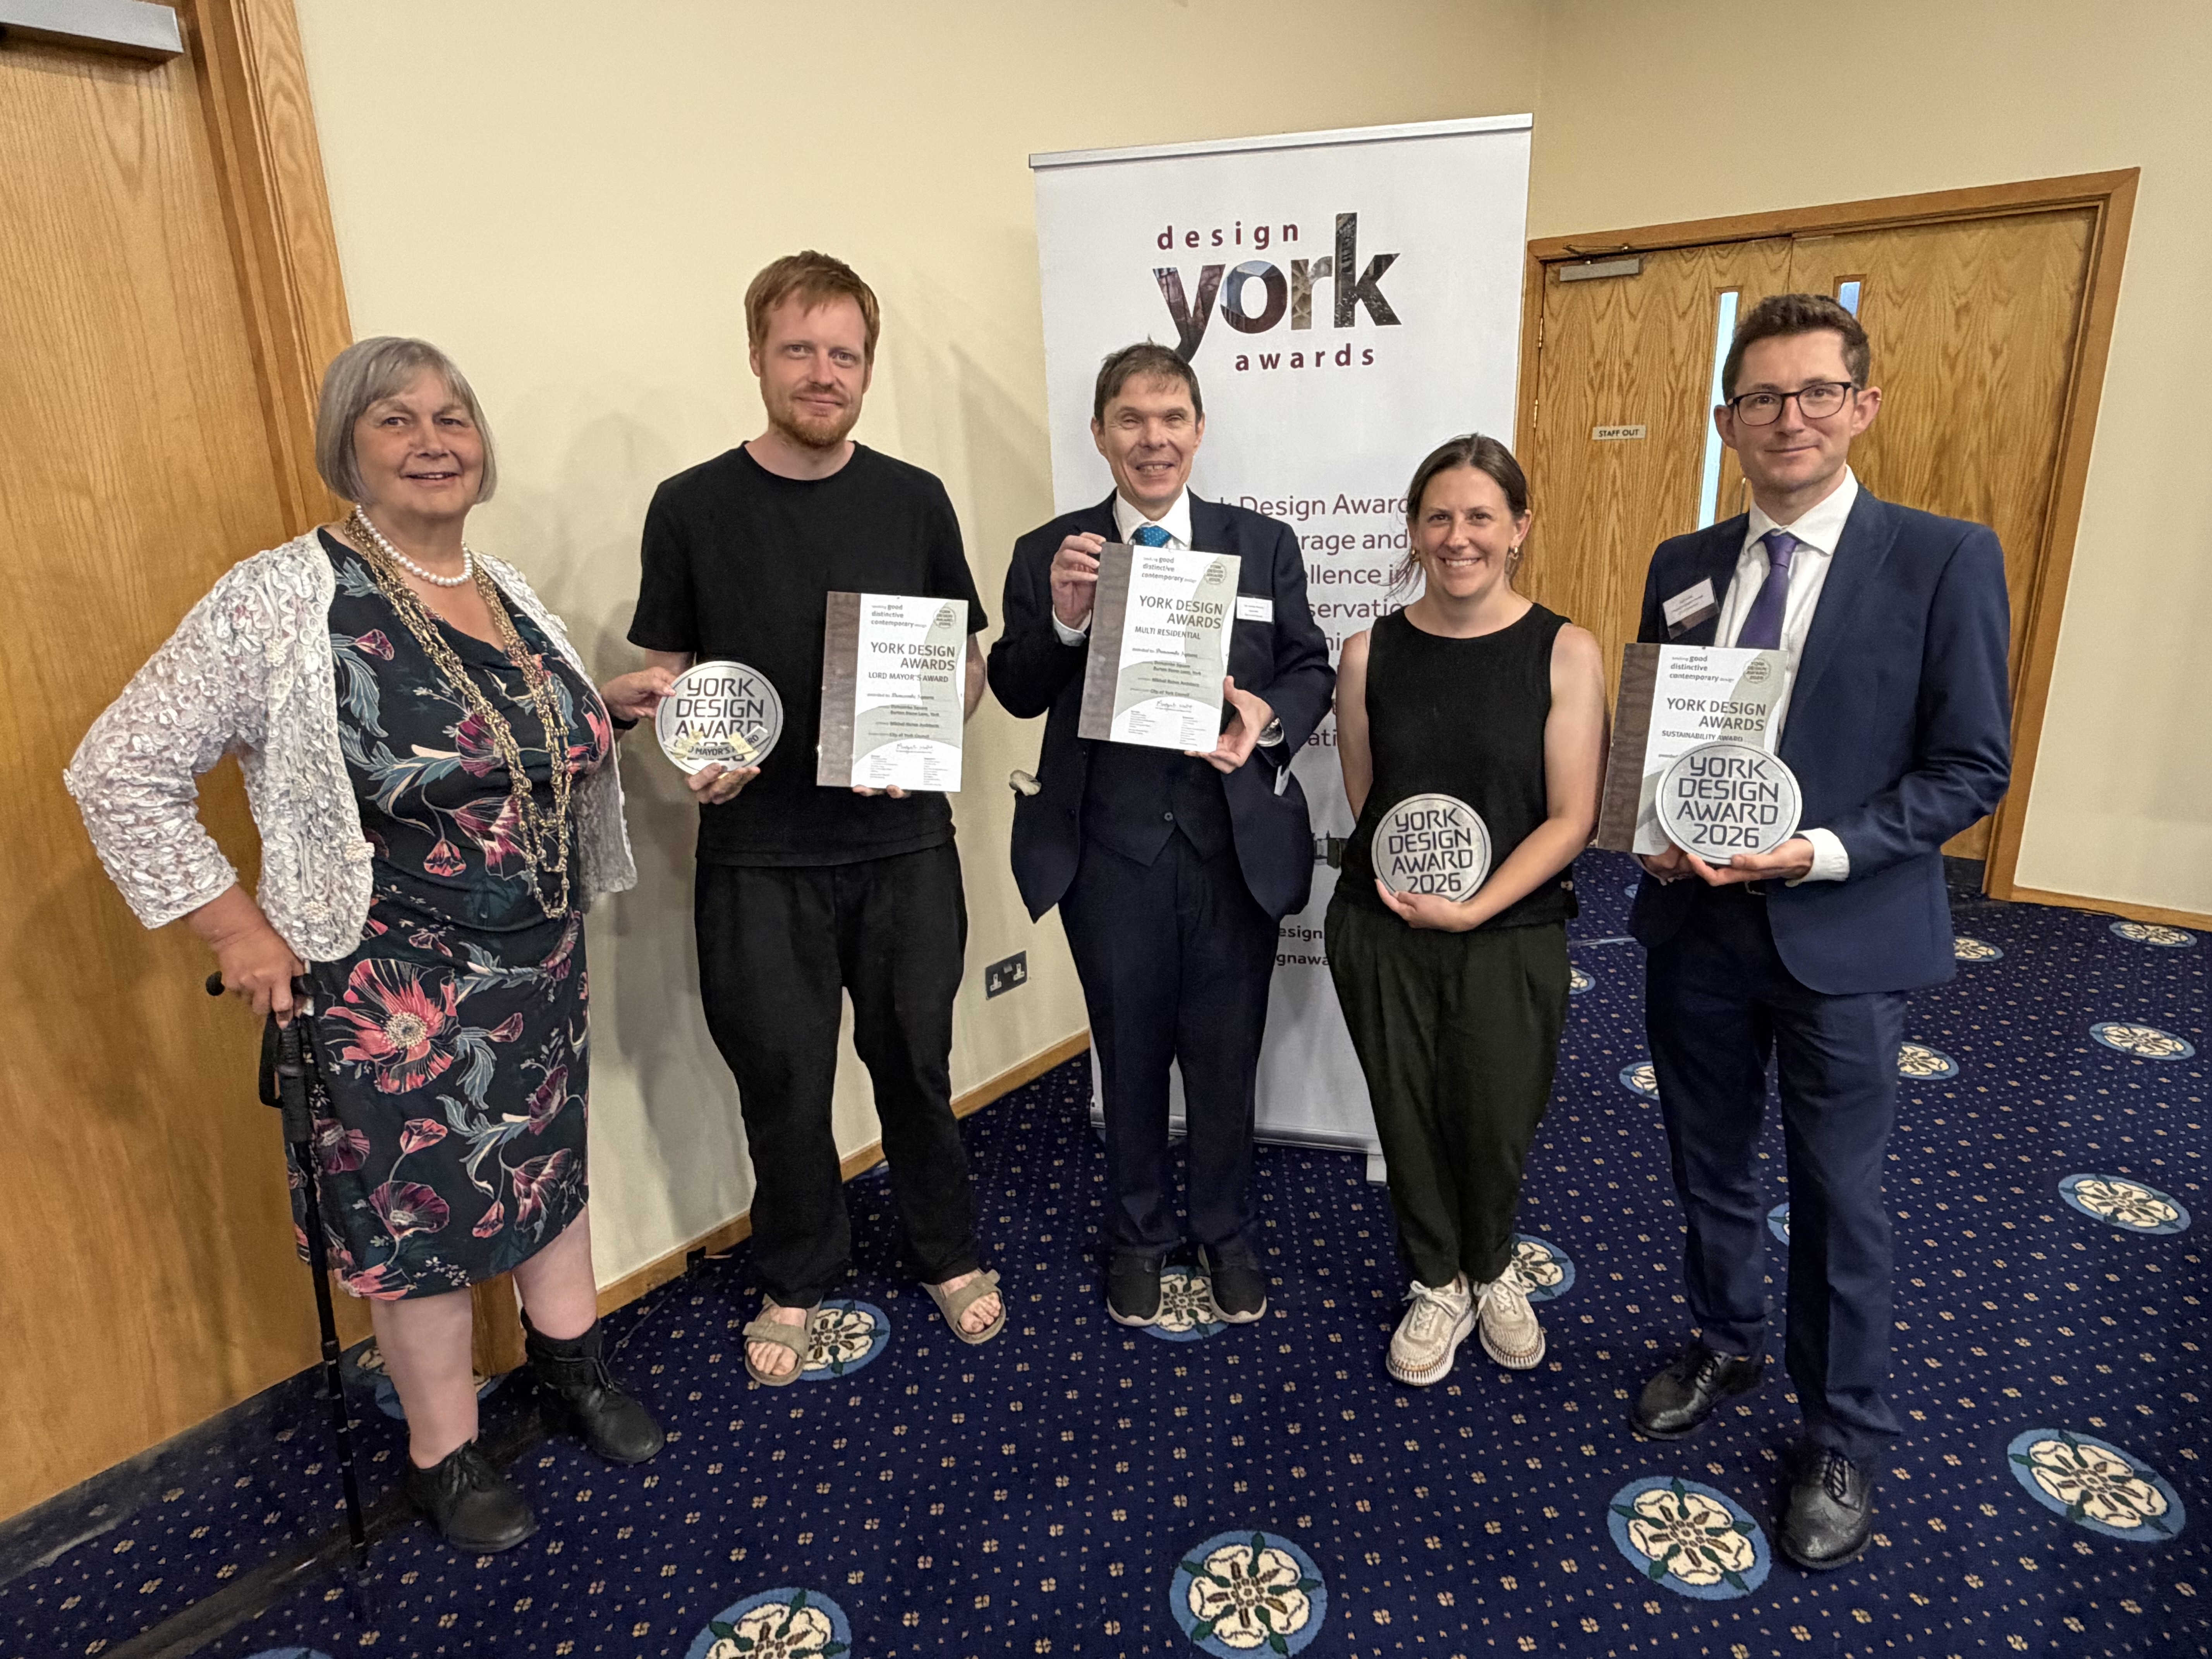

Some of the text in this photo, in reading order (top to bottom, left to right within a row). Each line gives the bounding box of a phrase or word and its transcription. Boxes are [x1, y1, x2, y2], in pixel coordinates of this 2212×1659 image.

[1158, 221, 1299, 250] design
[1152, 212, 1402, 364] york
[1235, 343, 1375, 371] awards
[1240, 496, 1325, 521] Design
[1362, 529, 1408, 549] and
[1142, 563, 1175, 571] distinctive
[1142, 573, 1184, 583] contemporary
[1139, 595, 1223, 615] YORK DESIGN
[1167, 613, 1221, 629] AWARDS
[1135, 626, 1201, 640] MULTI RESIDENTIAL
[871, 642, 955, 658] YORK DESIGN
[900, 657, 955, 670] AWARDS
[687, 678, 755, 697] YORK
[1669, 673, 1719, 682] contemporary
[676, 699, 764, 718] DESIGN
[1667, 697, 1766, 716] YORK DESIGN
[1699, 716, 1764, 731] AWARDS
[1661, 730, 1716, 740] SUSTAINABILITY
[696, 747, 730, 756] MAYOR'S
[1690, 756, 1767, 779] YORK
[1678, 778, 1778, 802] DESIGN
[1395, 808, 1461, 832] YORK
[1676, 800, 1778, 824] AWARD
[1389, 828, 1471, 854] DESIGN
[1692, 823, 1759, 848] 2026
[1392, 849, 1472, 875] AWARD
[1406, 872, 1461, 893] 2026
